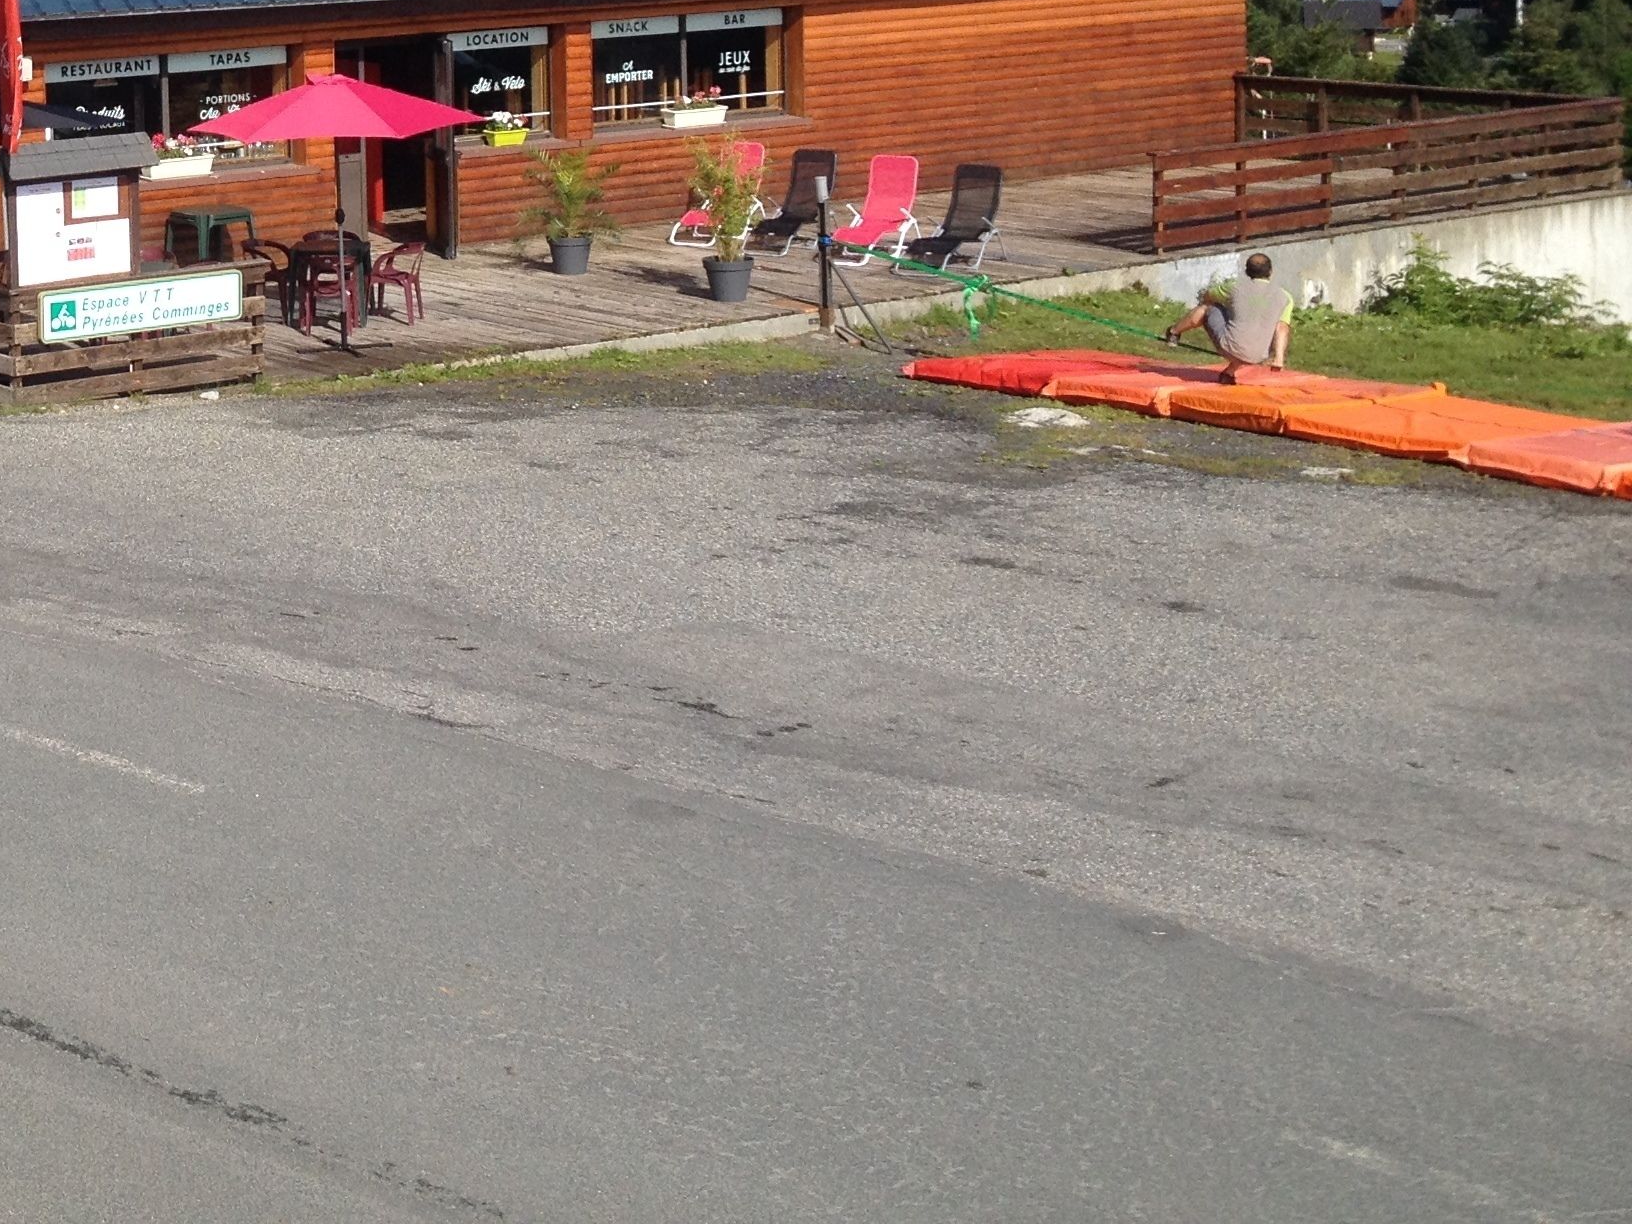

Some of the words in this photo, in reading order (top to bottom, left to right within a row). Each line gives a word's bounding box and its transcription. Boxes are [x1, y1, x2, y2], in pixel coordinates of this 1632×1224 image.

[724, 13, 745, 25] BAR
[608, 20, 648, 34] SNACK
[466, 32, 529, 46] LOCATION
[209, 51, 250, 65] TAPAS
[718, 50, 750, 66] JEUX
[61, 59, 151, 77] RESTAURANT
[605, 69, 654, 84] EMPORTER
[205, 92, 251, 104] PORTIONS
[82, 296, 129, 312] Espace
[82, 311, 144, 331] Pyrénées
[152, 301, 230, 321] Comminges
